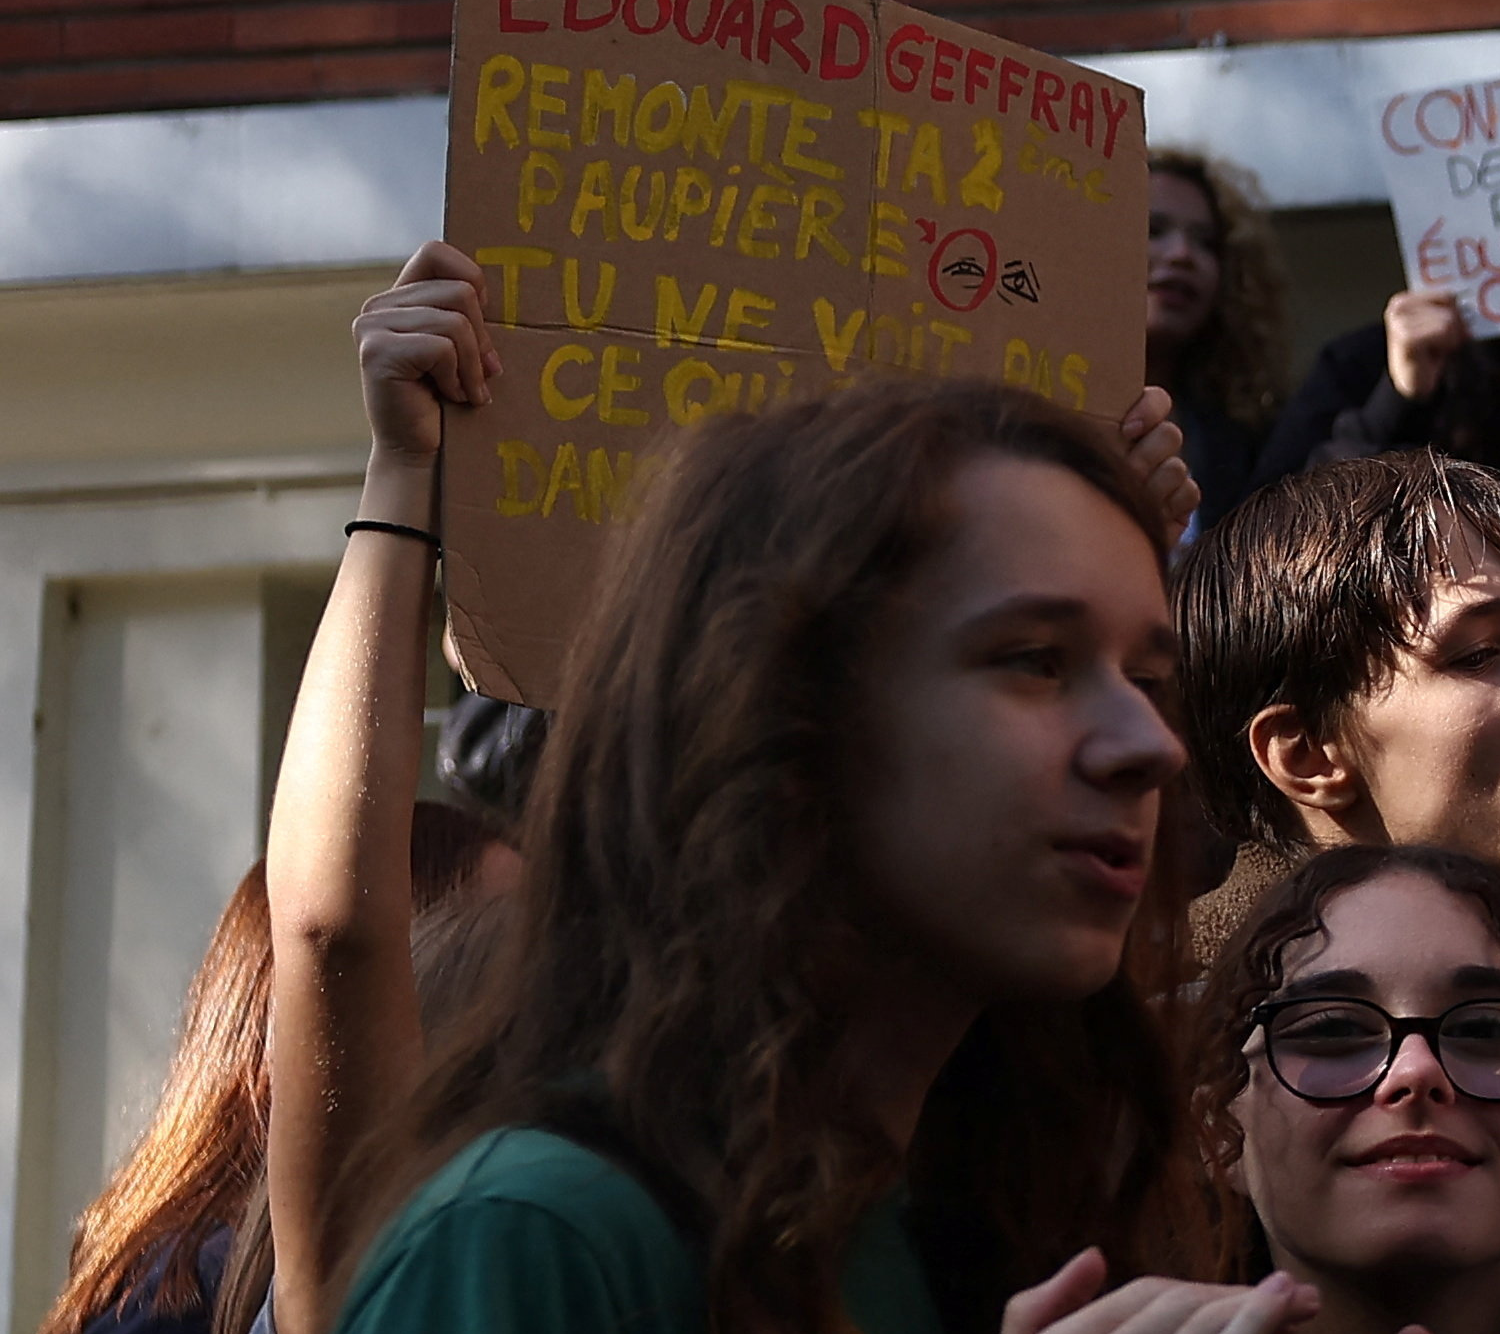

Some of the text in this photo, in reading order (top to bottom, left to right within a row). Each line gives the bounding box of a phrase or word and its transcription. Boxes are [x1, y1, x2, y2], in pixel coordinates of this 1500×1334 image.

[473, 52, 846, 181] REMONTE
[857, 107, 949, 207] TA
[884, 22, 1130, 160] GEFFRAY
[475, 245, 615, 332] TU
[655, 274, 778, 354] NE
[1003, 337, 1091, 413] PAS
[539, 344, 651, 428] CE
